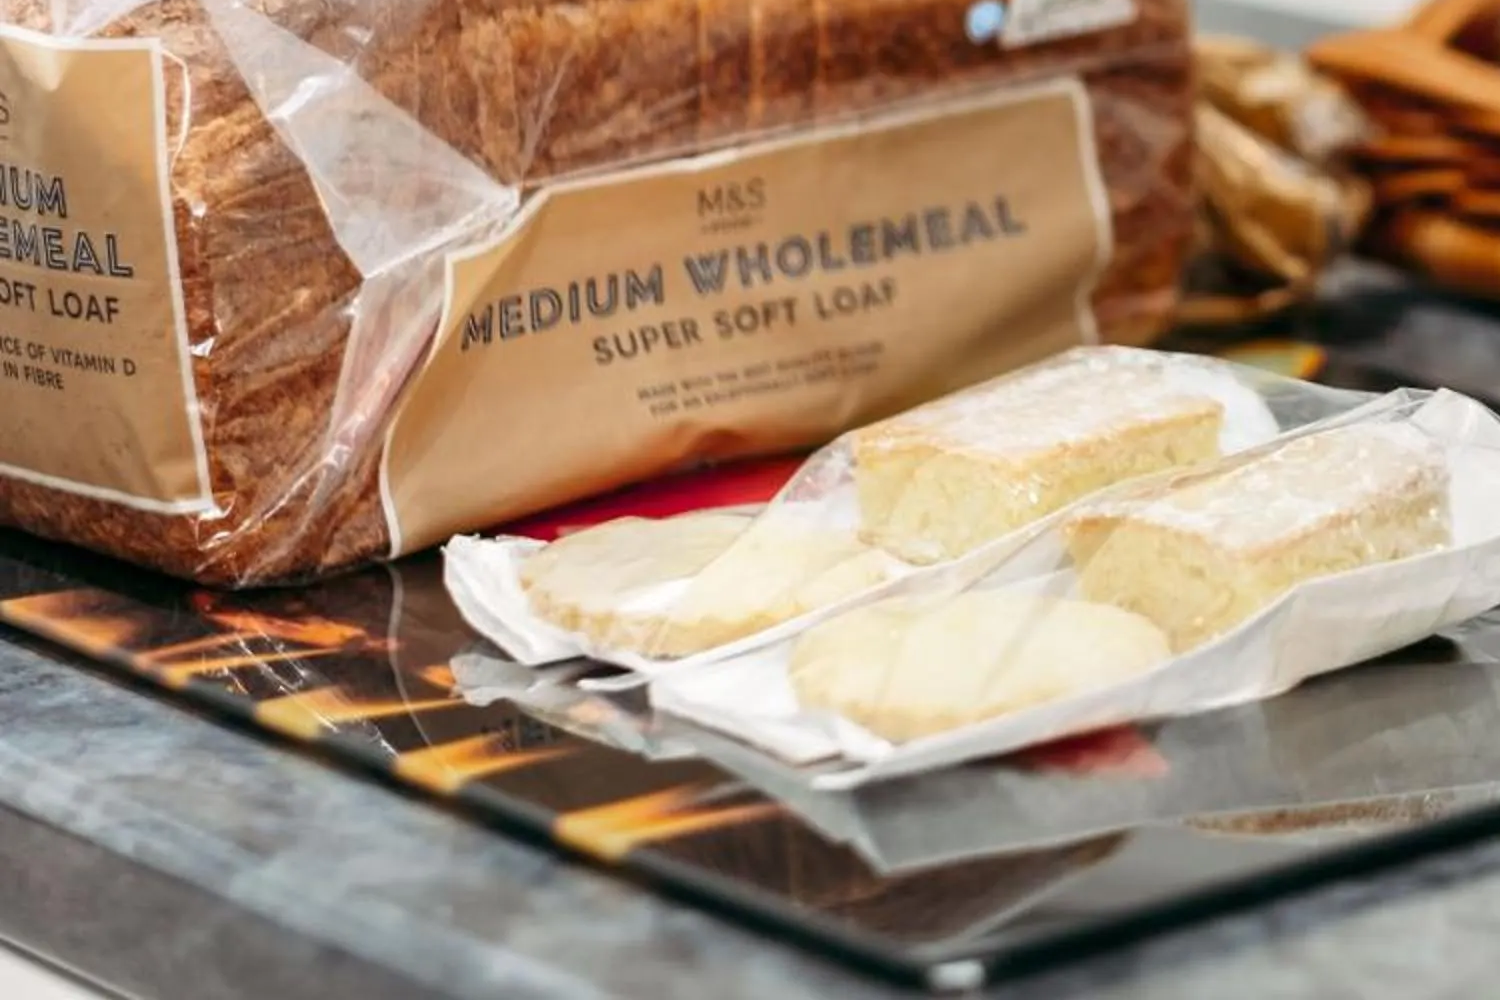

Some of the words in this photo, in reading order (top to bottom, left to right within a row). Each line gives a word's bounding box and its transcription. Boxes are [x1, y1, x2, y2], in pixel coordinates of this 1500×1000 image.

[697, 177, 767, 217] M&S
[461, 263, 664, 354] MEDIUM
[683, 195, 1028, 297] WHOLEMEAL
[48, 287, 120, 324] LOAF
[593, 318, 703, 367] SUPER
[714, 297, 799, 338] SOFT
[814, 277, 897, 321] LOAF
[3, 361, 19, 380] IN
[23, 365, 65, 390] FIBRE
[27, 342, 46, 361] OF
[50, 346, 116, 374] VITAMIN
[122, 357, 136, 377] D
